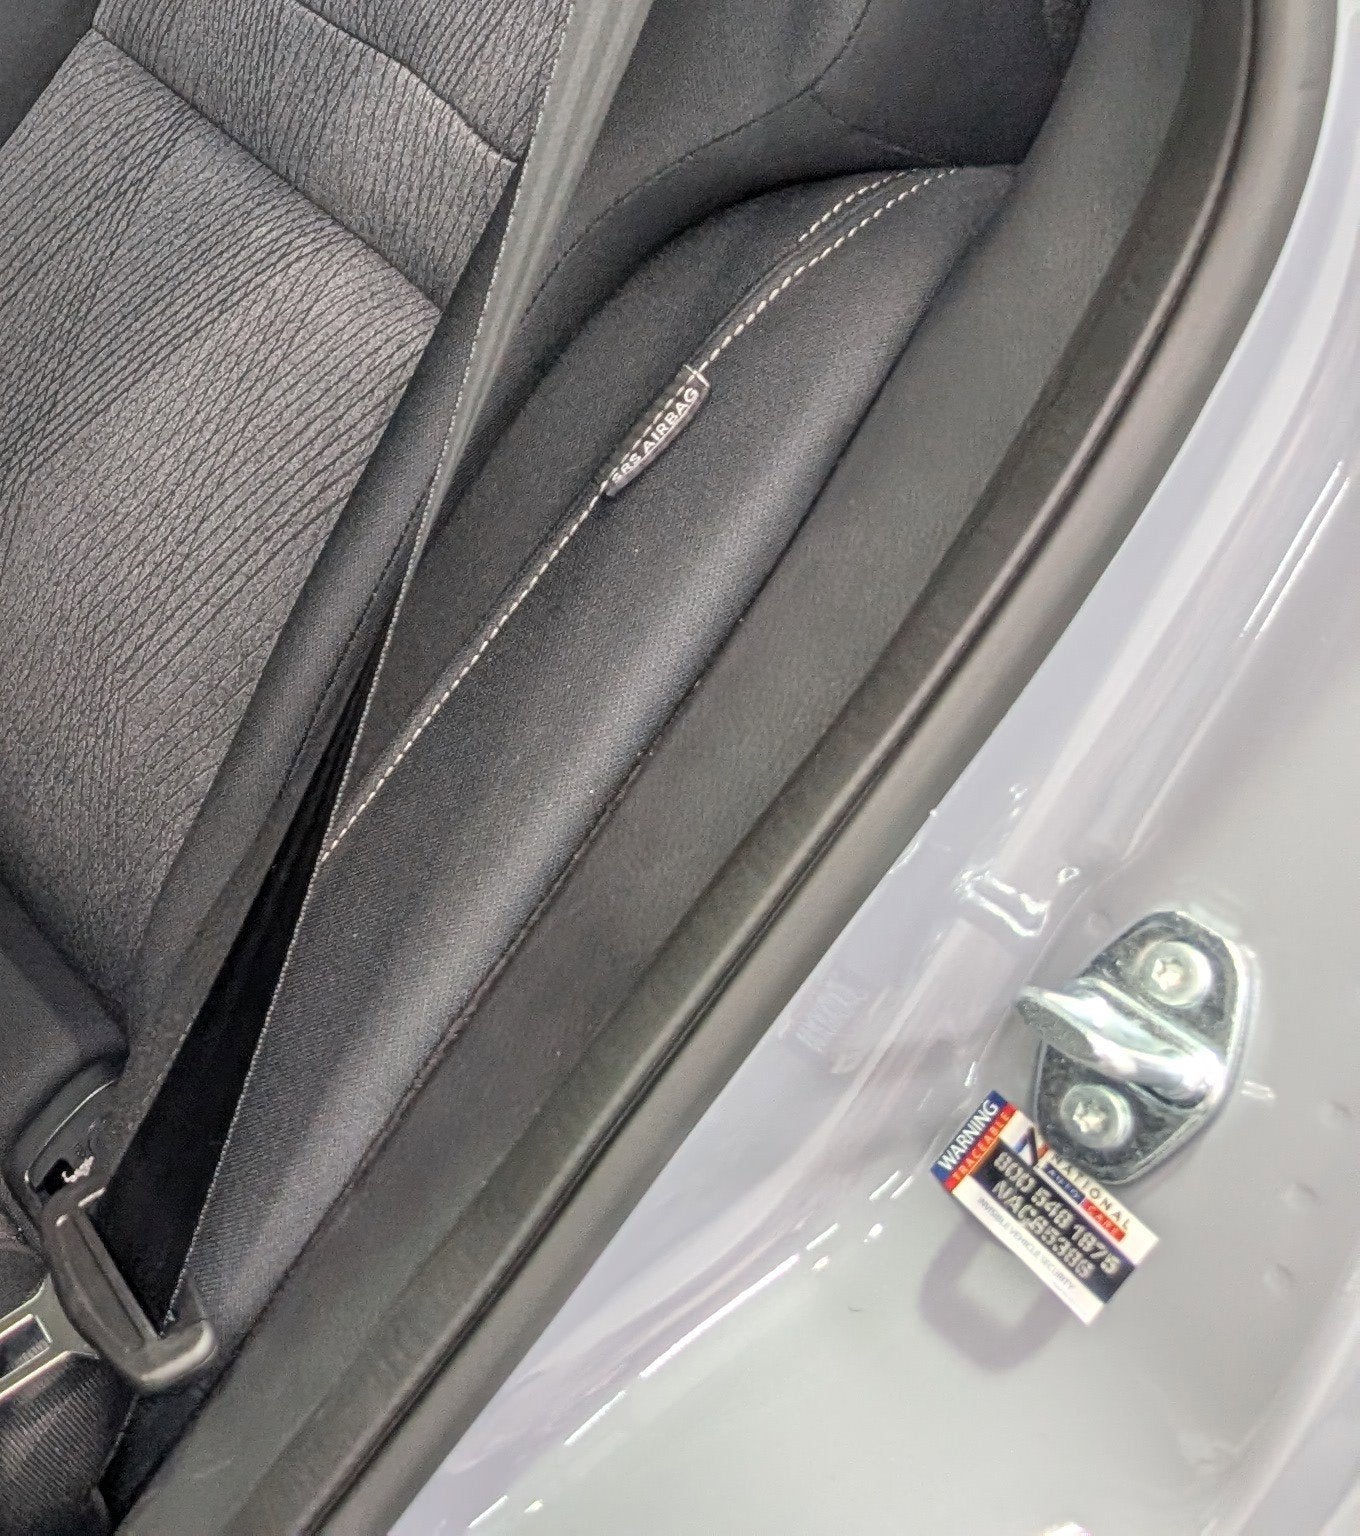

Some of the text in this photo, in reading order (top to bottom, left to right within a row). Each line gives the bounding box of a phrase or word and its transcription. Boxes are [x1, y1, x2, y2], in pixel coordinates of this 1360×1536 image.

[643, 387, 699, 453] AIRBAG
[937, 1099, 999, 1171] WARNING
[952, 1112, 1012, 1181] TRACEABLE
[994, 1151, 1037, 1194] 800
[1072, 1223, 1122, 1275] 1875
[1049, 1149, 1131, 1230] NATIONAL
[1008, 1226, 1042, 1259] VEHICLE
[1038, 1255, 1077, 1291] SECURITY
